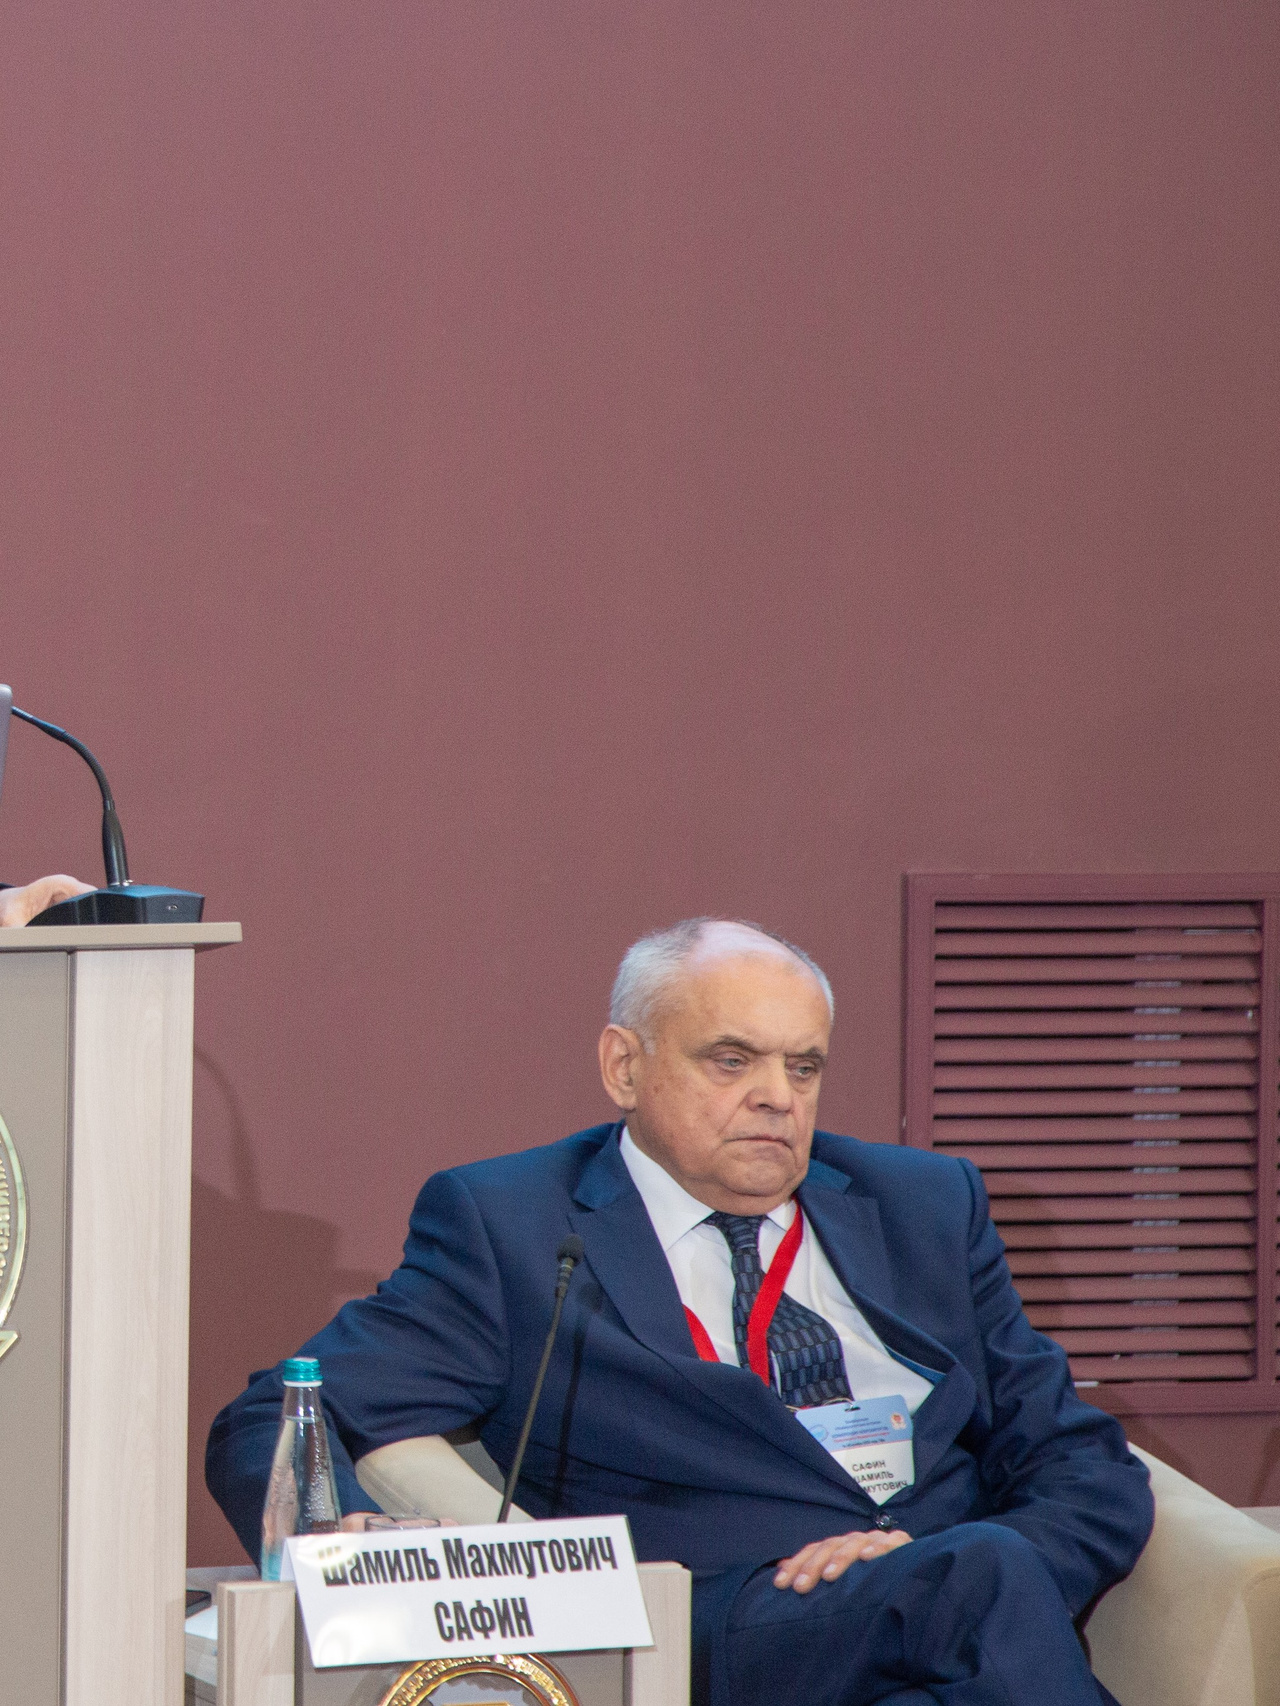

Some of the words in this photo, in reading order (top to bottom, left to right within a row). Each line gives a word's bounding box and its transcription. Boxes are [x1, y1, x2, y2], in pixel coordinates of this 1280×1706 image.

[852, 1460, 887, 1472] САФИН
[863, 1480, 908, 1494] МУТОВИЧ
[318, 1544, 440, 1587] Шамиль
[440, 1535, 619, 1580] Махмутович
[434, 1596, 534, 1643] САФИН
